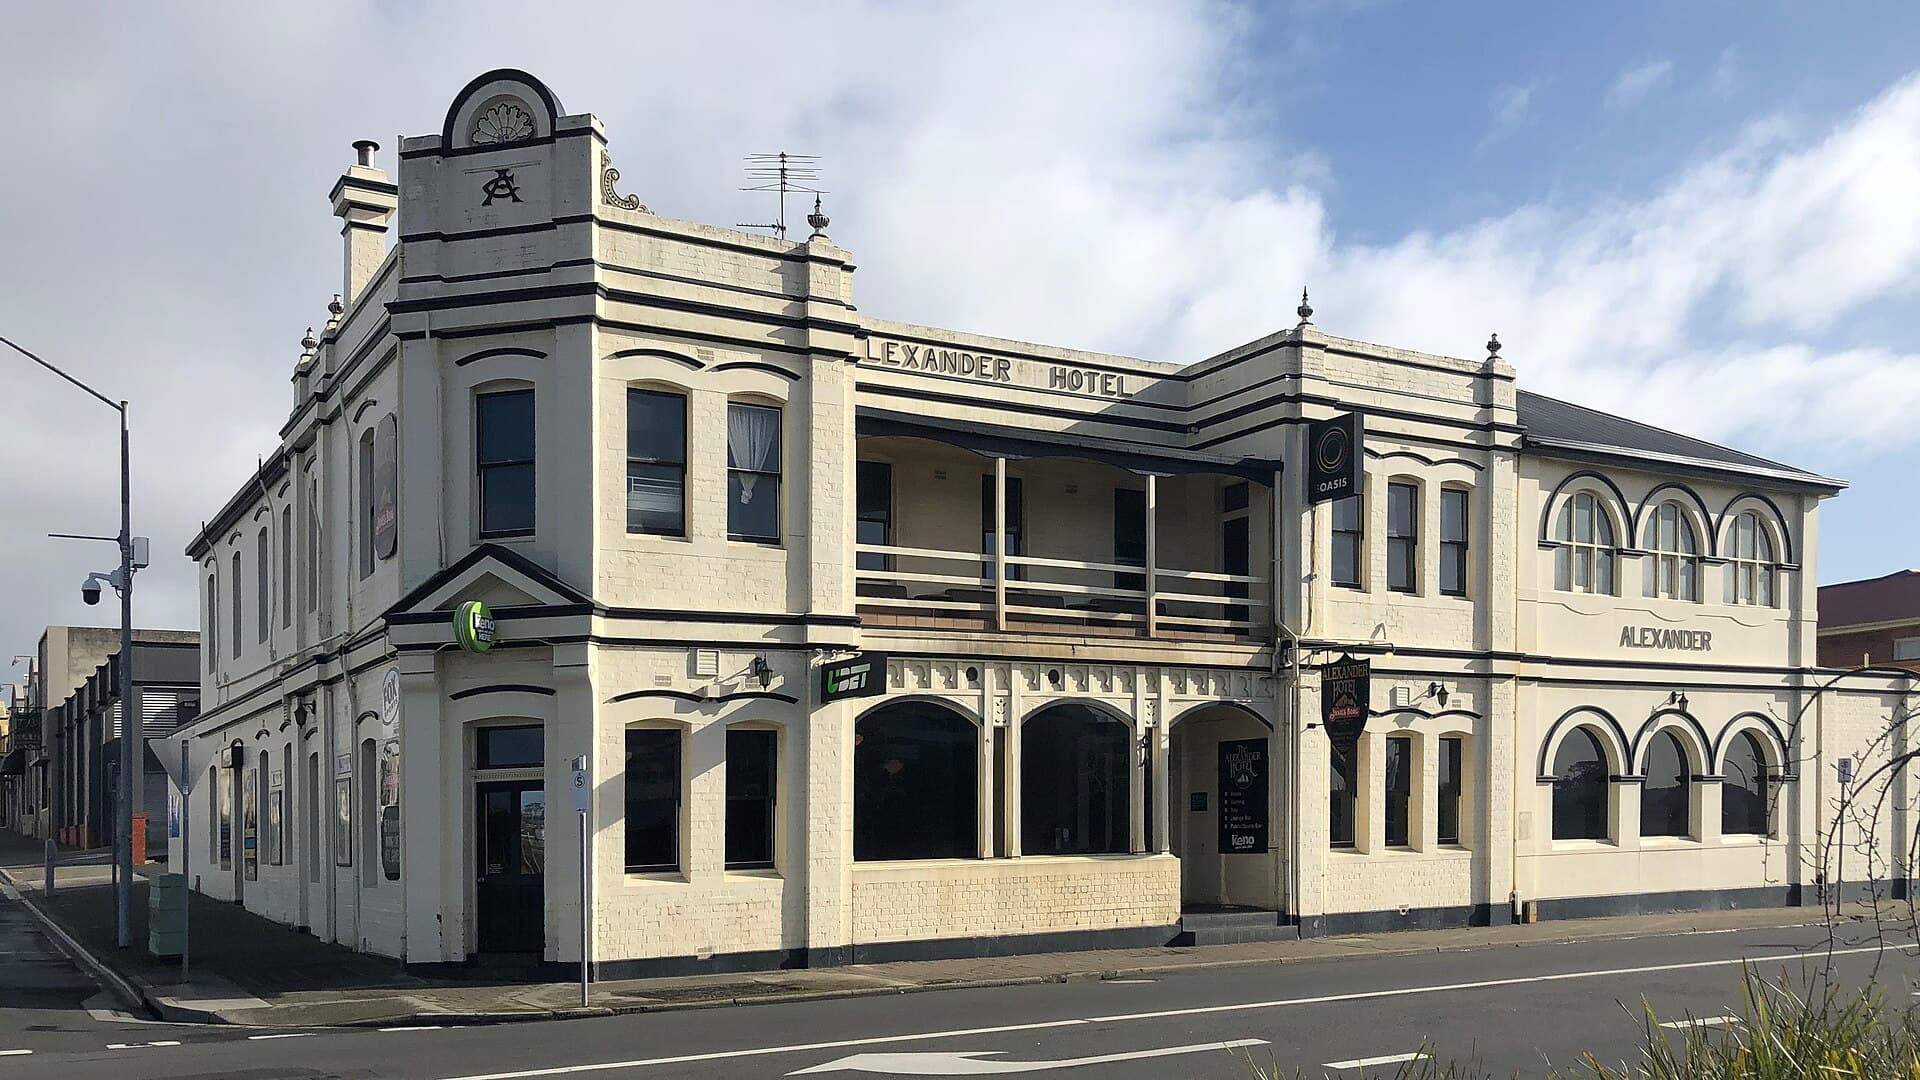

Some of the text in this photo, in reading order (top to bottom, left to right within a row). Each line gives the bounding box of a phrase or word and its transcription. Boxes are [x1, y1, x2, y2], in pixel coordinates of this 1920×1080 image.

[863, 337, 1133, 398] LEXANDER HOTEL
[1320, 477, 1348, 493] OASIS
[474, 612, 495, 631] Keno
[1619, 625, 1712, 651] ALEXANDER
[1322, 664, 1368, 681] ALEXANDER
[1333, 680, 1358, 702] HOTEL
[1231, 834, 1255, 846] Keno
